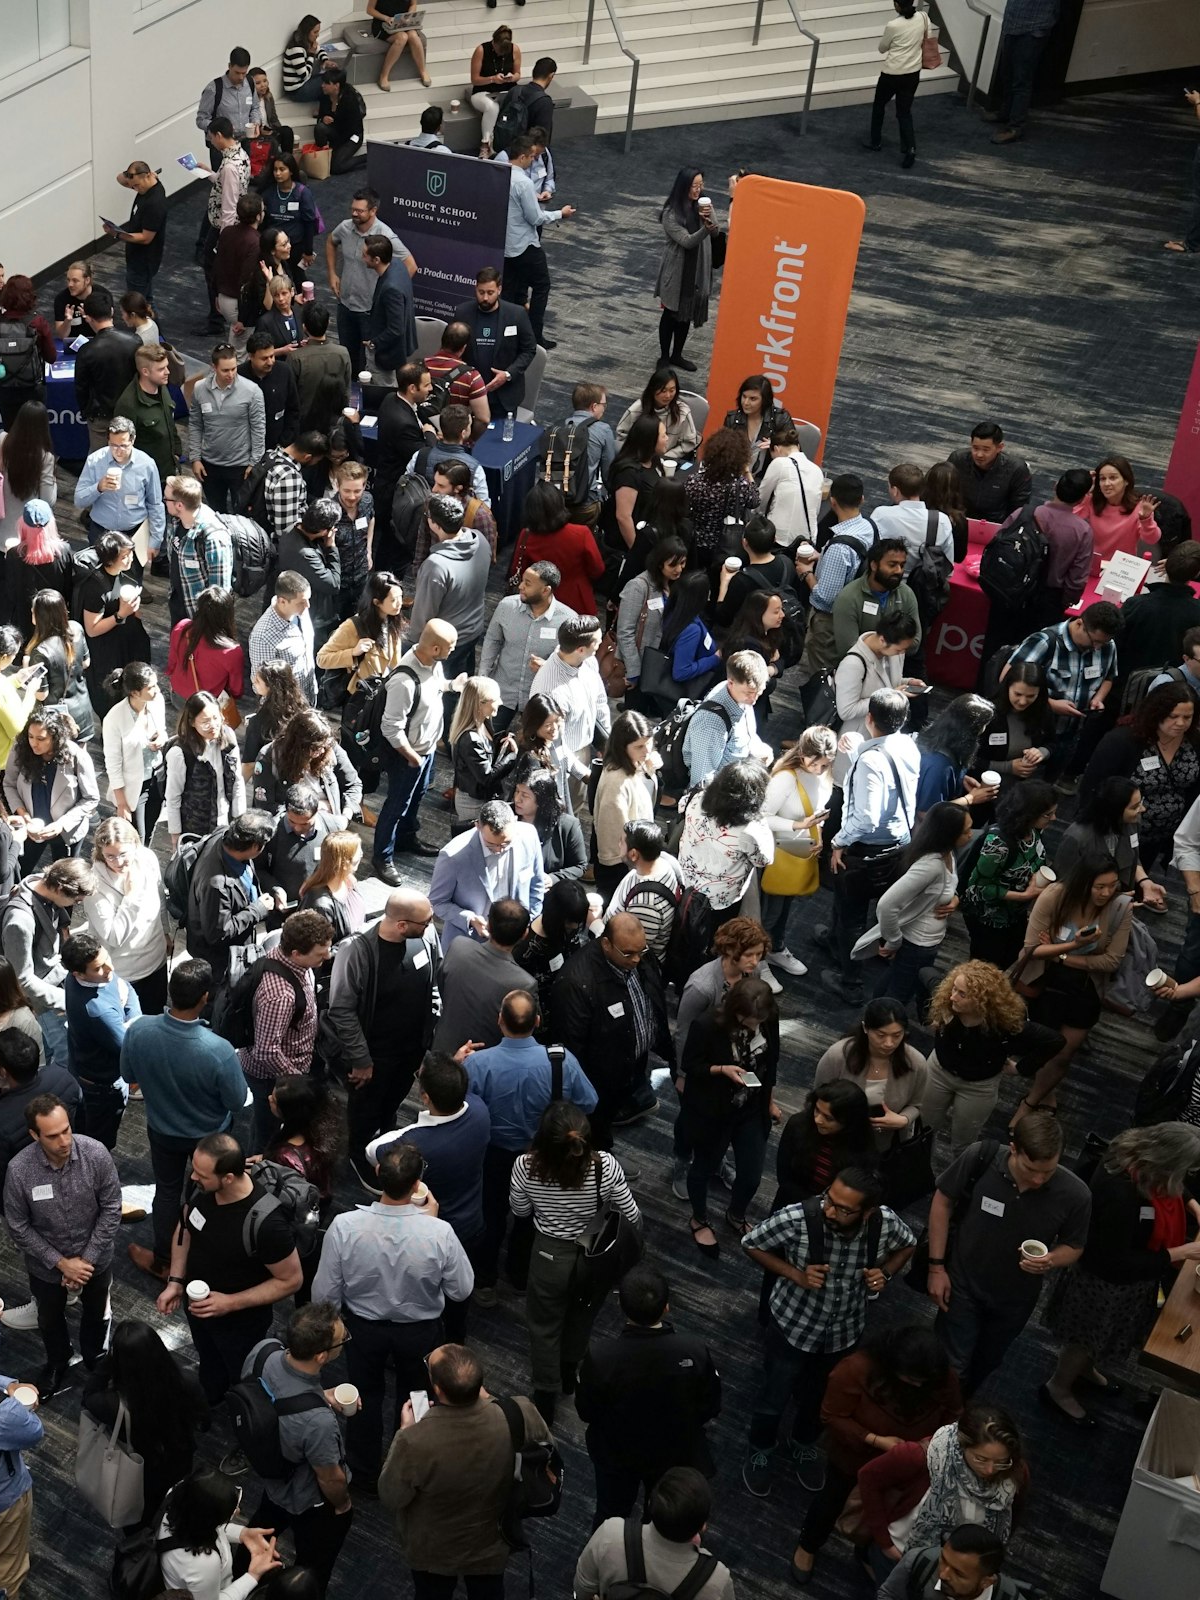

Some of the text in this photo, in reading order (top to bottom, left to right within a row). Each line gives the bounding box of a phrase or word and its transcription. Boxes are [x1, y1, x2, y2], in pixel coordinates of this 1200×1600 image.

[393, 196, 478, 220] PRODUCT SCHOOL
[408, 212, 461, 226] SILICON VALLEY
[423, 267, 453, 281] Product
[454, 274, 477, 286] Mana
[756, 240, 808, 408] orkfront
